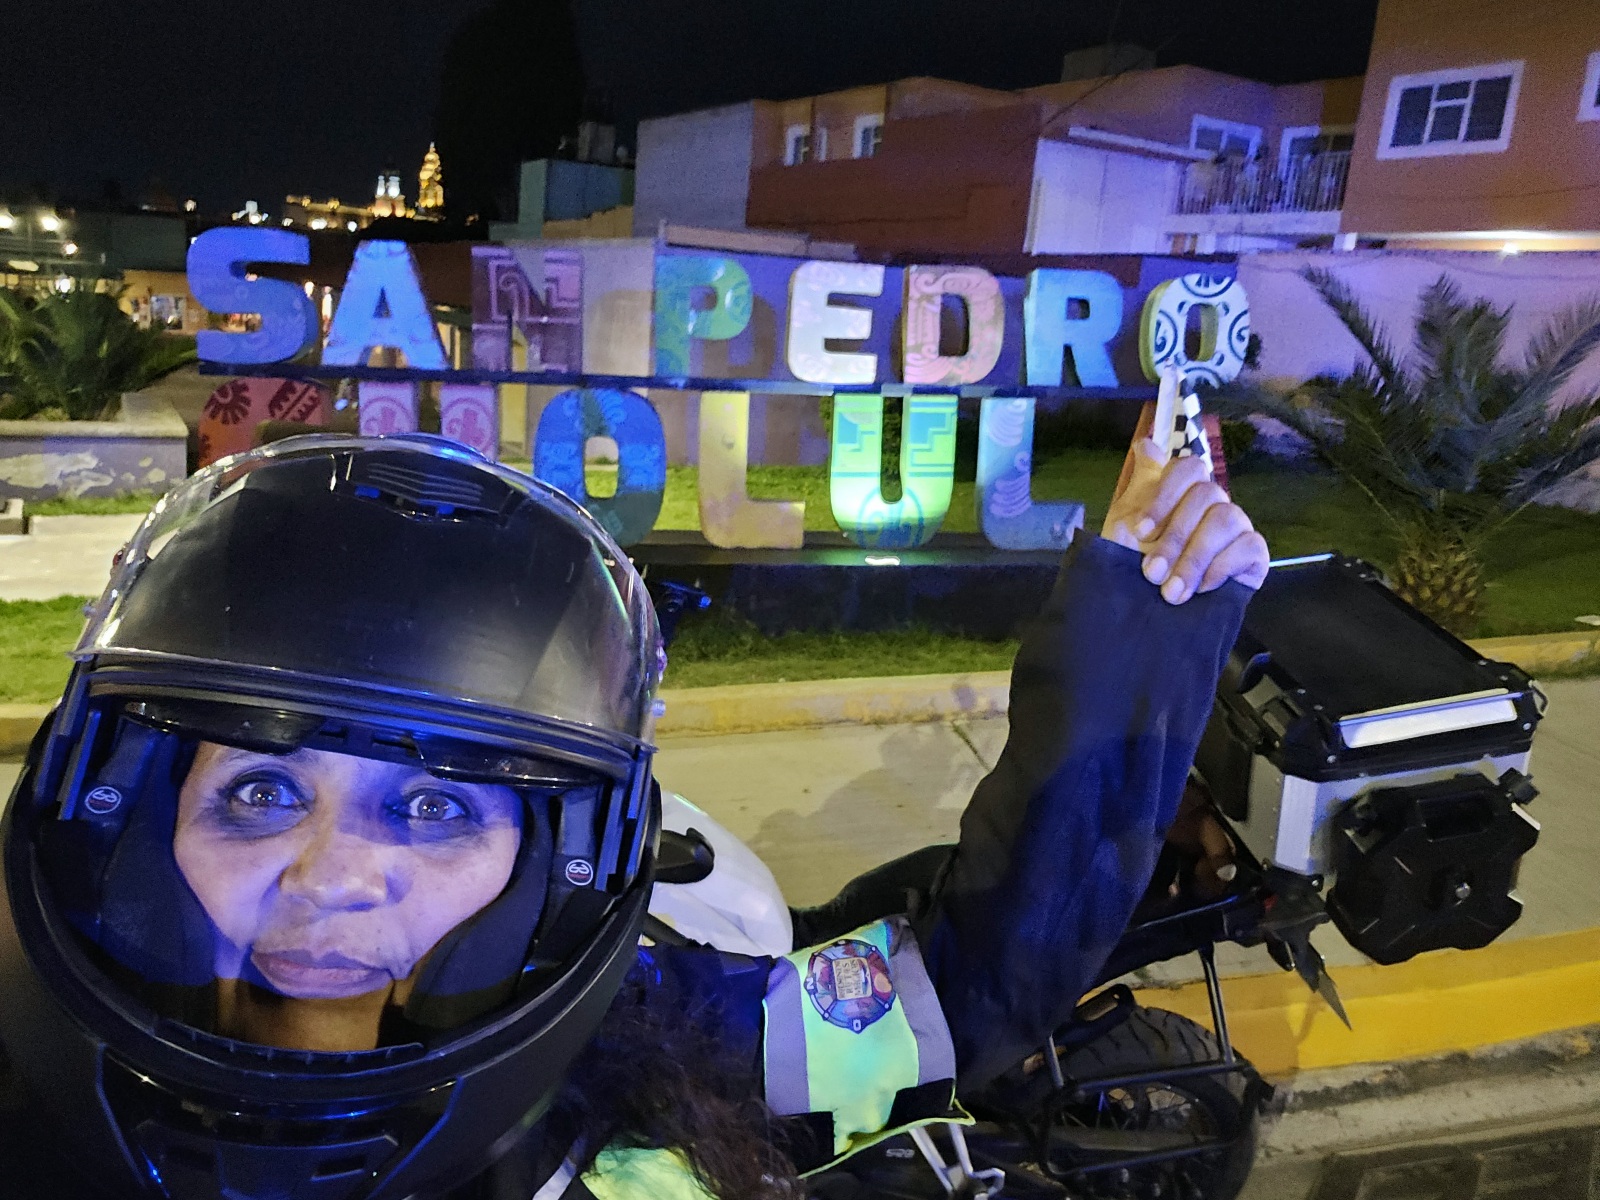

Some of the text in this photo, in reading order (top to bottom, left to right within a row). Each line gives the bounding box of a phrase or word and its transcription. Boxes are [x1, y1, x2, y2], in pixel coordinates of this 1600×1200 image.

[186, 226, 1251, 388] SAN PEDRO
[199, 377, 1231, 550] OLUL
